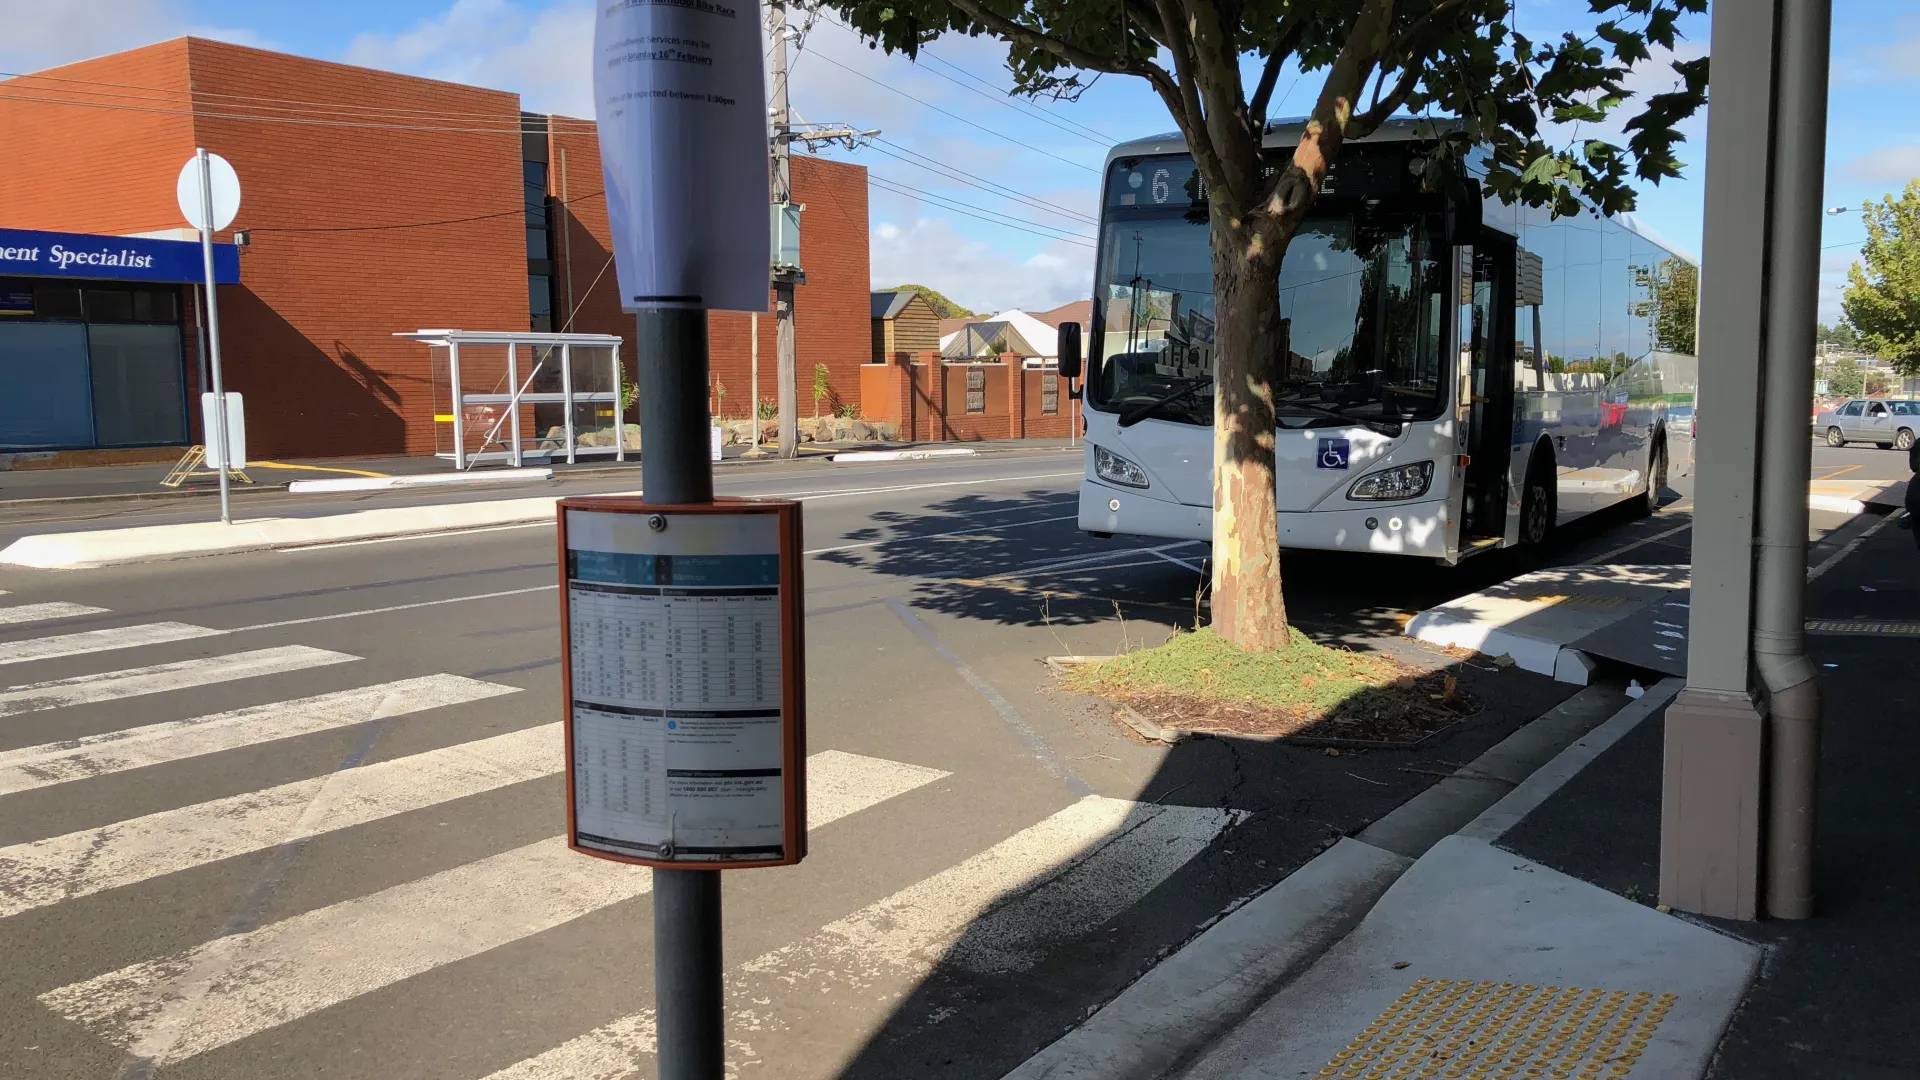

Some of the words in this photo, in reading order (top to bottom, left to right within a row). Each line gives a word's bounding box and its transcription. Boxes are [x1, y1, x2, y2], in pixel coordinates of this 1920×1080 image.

[696, 0, 714, 11] Bike
[716, 4, 737, 15] Race
[648, 36, 680, 44] Services
[682, 39, 698, 48] may
[627, 49, 656, 60] Saturday
[659, 48, 675, 58] 16th
[677, 52, 713, 65] February
[634, 89, 667, 99] expected
[669, 90, 705, 102] between
[707, 93, 736, 106] 1:30pm
[1152, 168, 1170, 204] 6
[49, 244, 153, 270] Specialist
